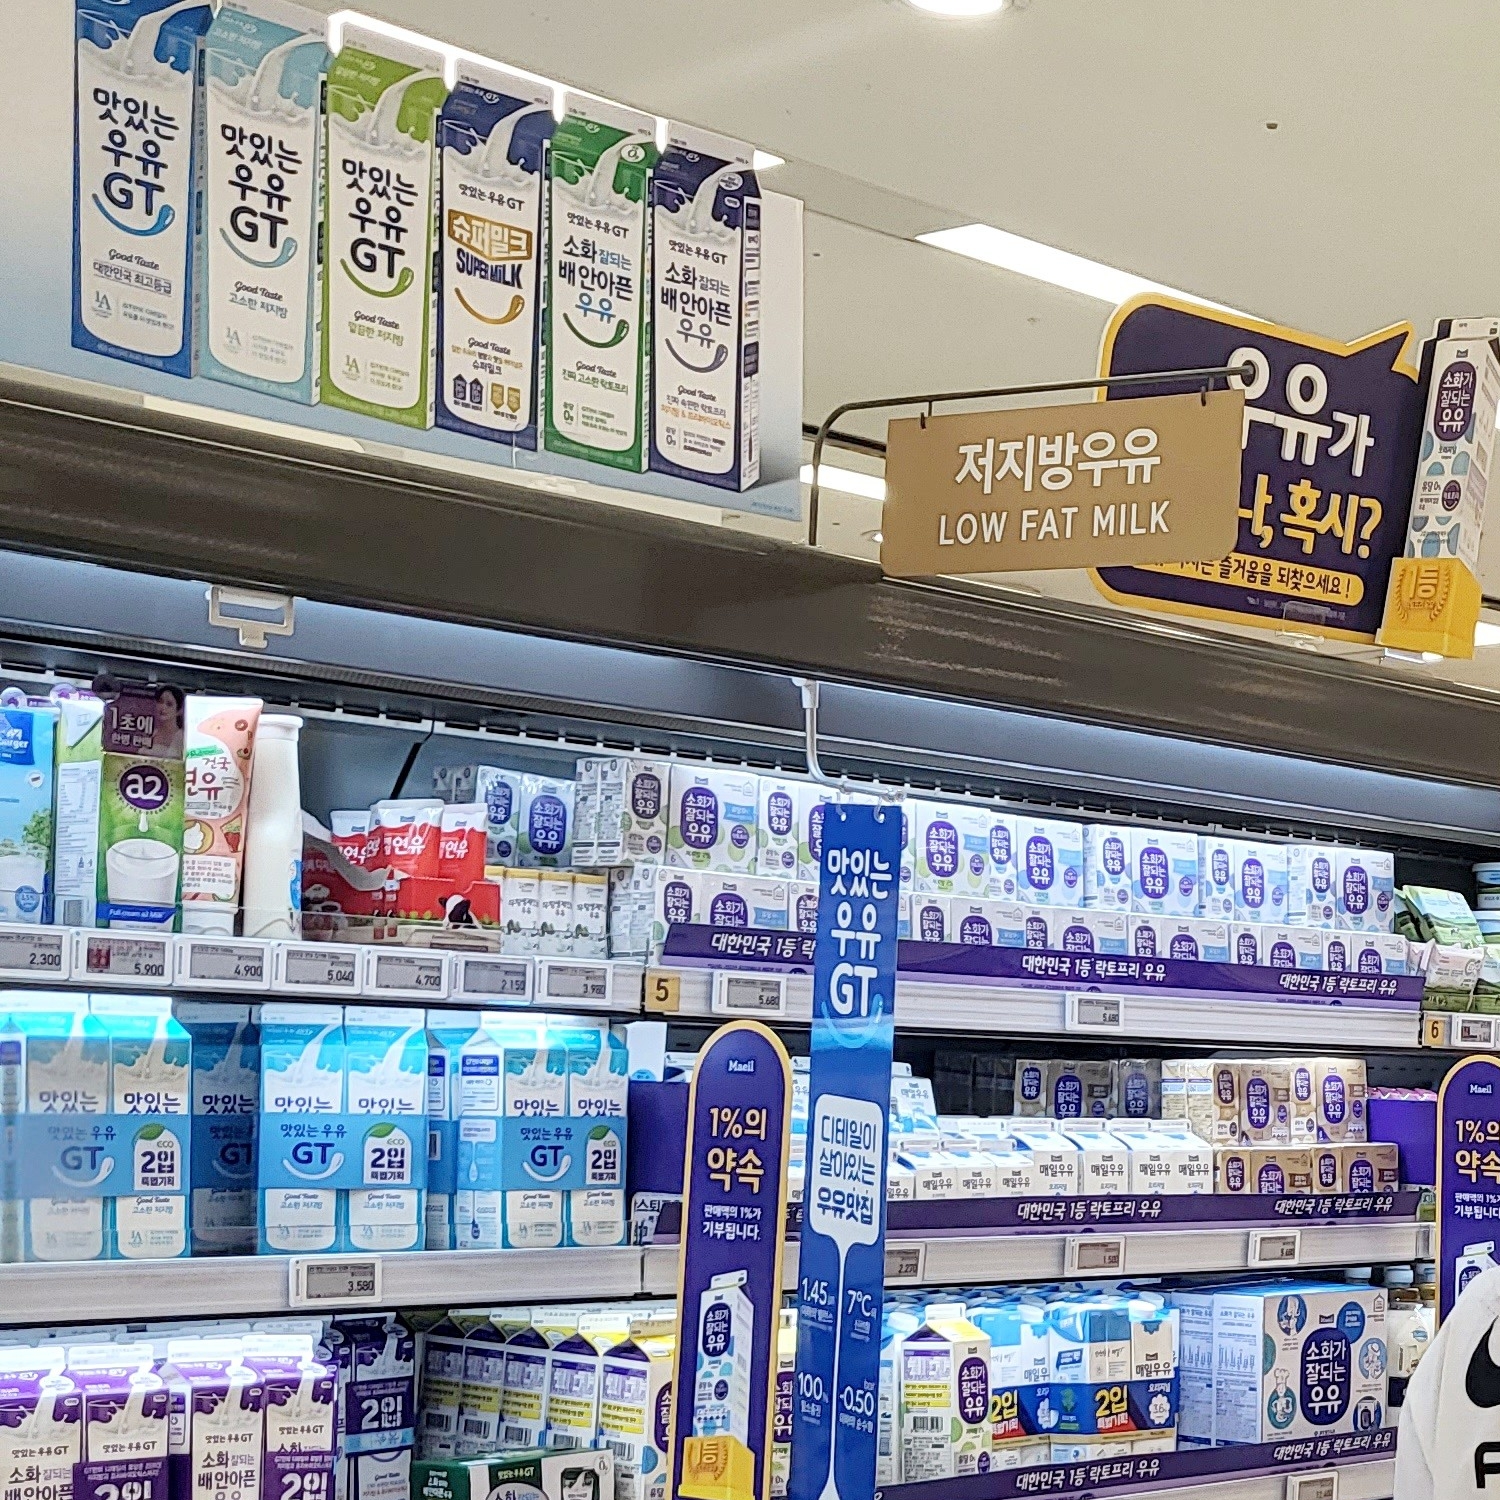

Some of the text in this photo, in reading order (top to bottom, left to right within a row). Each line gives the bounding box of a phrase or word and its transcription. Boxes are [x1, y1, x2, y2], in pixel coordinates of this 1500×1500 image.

[93, 87, 179, 141] 맛있는
[101, 129, 168, 179] 우유
[220, 123, 302, 174] 맛있는
[228, 164, 291, 211] 우유
[342, 158, 418, 207] 맛있는
[230, 206, 289, 249] GT
[348, 197, 408, 243] 우유
[451, 214, 529, 259] 슈퍼밀크
[350, 238, 406, 279] GT
[563, 235, 632, 271] 소화 잘되는
[578, 264, 633, 302] 안아픈
[664, 260, 697, 290] 소화
[679, 289, 732, 327] 안아픈
[1227, 346, 1375, 477] 우유가
[955, 428, 1162, 491] 저지방우유
[939, 501, 1170, 546] LOW FAT MILK
[1280, 478, 1382, 558] 혹시?
[1218, 555, 1273, 586] 즐거움을
[110, 706, 153, 735] 1초에
[126, 775, 163, 801] a2
[827, 847, 893, 900] 맛있는
[711, 932, 773, 956] 대한민국
[656, 978, 669, 1001] 5
[828, 962, 879, 1017] GT
[1430, 1021, 1440, 1040] 6
[728, 1059, 755, 1073] Maeil
[280, 1123, 347, 1139] 맛있는 우유
[709, 1107, 768, 1141] 1%의
[821, 1114, 877, 1153] 디테일이
[707, 1147, 765, 1194] 약속
[818, 1151, 876, 1187] 살아있는
[816, 1184, 874, 1226] 우유맛집
[1017, 1201, 1066, 1221] 대한민국
[1089, 1200, 1136, 1219] 락토프리
[1138, 1200, 1162, 1217] 우유
[702, 1220, 761, 1241] 기부됩니다.
[802, 1277, 829, 1306] 1.45
[1305, 1339, 1346, 1361] 소화가
[798, 1371, 823, 1401] 100
[1305, 1361, 1347, 1386] 잘되는
[1015, 1471, 1066, 1492] 대한민국
[1089, 1463, 1134, 1485] 락토프리
[1136, 1458, 1160, 1478] 우유
